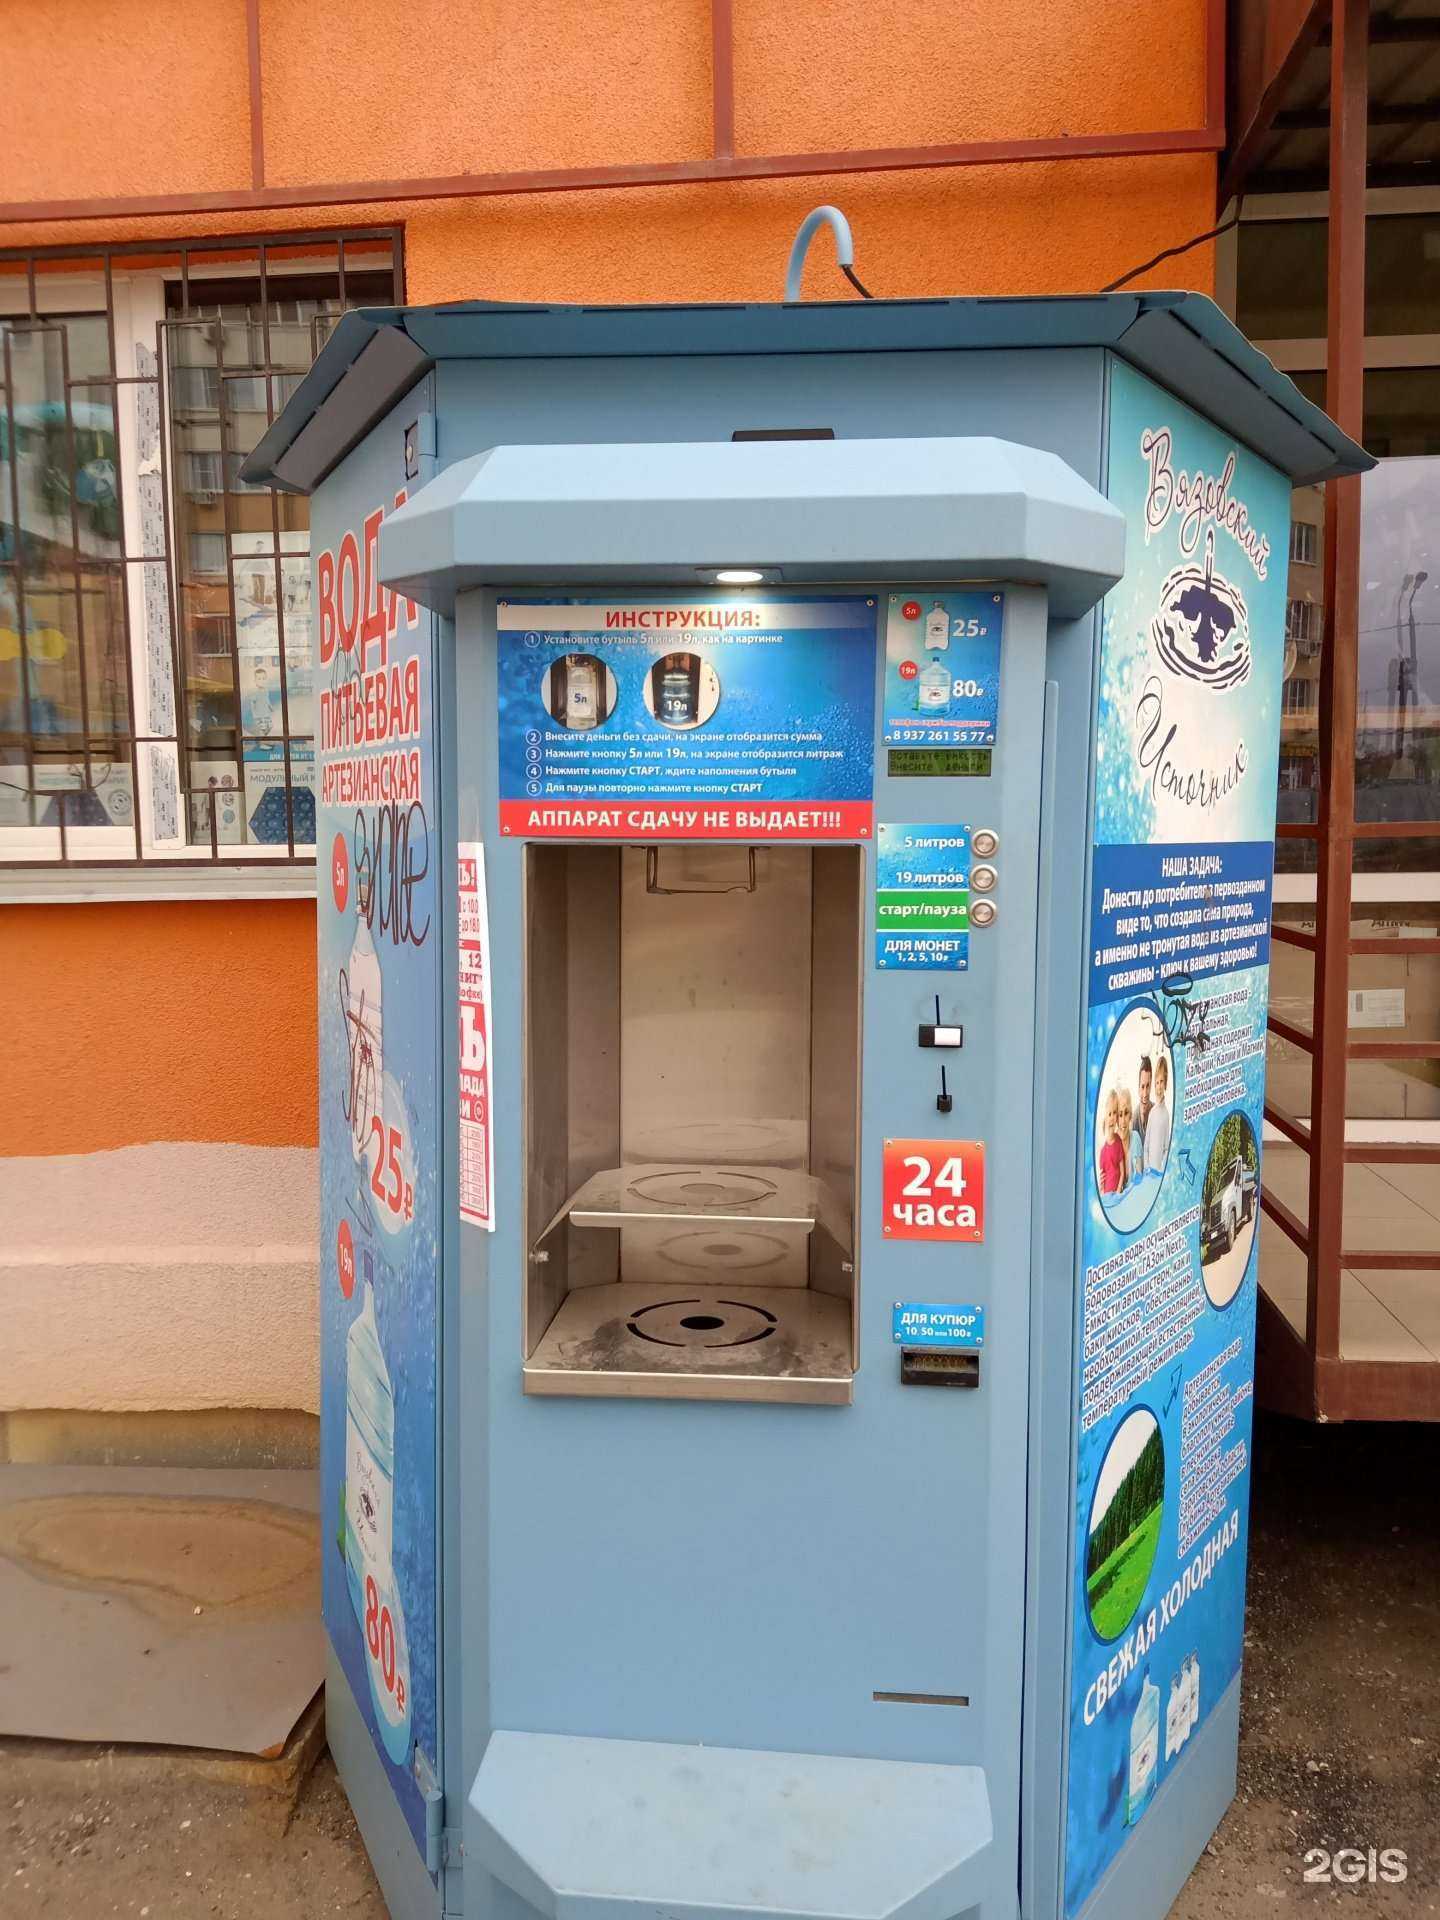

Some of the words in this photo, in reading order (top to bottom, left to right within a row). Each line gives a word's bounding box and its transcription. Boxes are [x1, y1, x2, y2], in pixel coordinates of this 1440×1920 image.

[1143, 432, 1269, 576] Вязовский
[605, 610, 760, 630] ИНСТРУКЦИЯ:
[544, 634, 600, 645] Установите
[601, 634, 638, 646] бутыль
[640, 633, 653, 644] 5л
[655, 635, 673, 644] или
[702, 634, 720, 645] как
[722, 635, 734, 644] на
[736, 634, 784, 646] картинке
[320, 658, 419, 751] ПИТЬЕВАЯ
[574, 692, 588, 703] 5л
[666, 700, 688, 712] 19л
[545, 731, 584, 741] Внесите
[586, 732, 621, 743] деньги
[623, 731, 640, 741] без
[642, 733, 673, 743] сдачи,
[676, 733, 687, 741] на
[690, 732, 724, 743] экране
[726, 730, 788, 743] отобразится
[790, 732, 823, 743] сумма
[893, 731, 900, 740] 8
[903, 731, 925, 741] 937
[928, 731, 949, 741] 261
[953, 732, 967, 741] 55
[970, 732, 985, 742] 77
[1136, 675, 1247, 808] Источник
[545, 748, 590, 759] Нажмите
[592, 750, 627, 761] кнопку
[629, 747, 643, 759] 5л
[644, 751, 663, 759] или
[666, 747, 689, 761] 19л,
[691, 751, 703, 759] на
[705, 750, 739, 760] экране
[741, 748, 804, 760] отобразится
[805, 750, 844, 760] литраж
[321, 752, 419, 802] АРТЕЗИАНСКАЯ
[545, 765, 590, 776] Нажмите
[592, 767, 627, 778] кнопку
[629, 766, 663, 777] СТАРТ,
[665, 767, 697, 778] ждите
[698, 767, 758, 777] наполнения
[760, 766, 797, 778] бутыля
[545, 782, 565, 794] Для
[566, 785, 597, 795] паузы
[599, 785, 646, 795] повторно
[648, 784, 691, 793] нажмите
[693, 784, 729, 795] кнопку
[730, 783, 763, 793] СТАРТ
[528, 810, 622, 827] АППАРАТ
[627, 810, 698, 830] СДАЧУ
[703, 811, 730, 828] НЕ
[736, 811, 841, 831] ВЫДАЕТ!!!
[905, 837, 913, 848] 5
[915, 838, 965, 850] литров
[335, 861, 345, 887] 5л
[896, 872, 912, 884] 19
[914, 873, 964, 885] литров
[1161, 856, 1189, 878] НАША
[1189, 854, 1223, 879] ЗАДАЧА:
[1102, 888, 1142, 914] Донести
[1142, 888, 1155, 909] до
[1155, 881, 1208, 907] потребителя
[1214, 878, 1266, 898] первозданном
[879, 903, 967, 917] старт/пауза
[1116, 917, 1139, 938] виде
[1140, 914, 1153, 933] то,
[1153, 912, 1169, 929] что
[1169, 908, 1202, 930] создала
[1203, 905, 1222, 923] сама
[1222, 901, 1254, 923] природа,
[884, 939, 912, 954] ДЛЯ
[914, 939, 961, 951] МОНЕТ
[1095, 951, 1102, 967] а
[1102, 943, 1139, 965] именно
[1139, 940, 1151, 957] не
[1151, 933, 1190, 959] тронутая
[1190, 930, 1210, 951] вода
[1210, 928, 1219, 942] из
[1220, 918, 1268, 945] артезианской
[897, 952, 906, 963] 1,
[919, 952, 928, 963] 5,
[1108, 965, 1155, 990] скважины
[1160, 959, 1184, 979] ключ
[1184, 959, 1189, 973] к
[1190, 953, 1219, 973] вашему
[1219, 942, 1258, 966] здоровью!
[1233, 989, 1248, 1004] вода
[1223, 1025, 1253, 1046] содержит
[1185, 1071, 1230, 1098] необходимые
[1230, 1066, 1242, 1082] для
[1184, 1097, 1216, 1121] здоровья
[902, 1155, 967, 1198] 24
[892, 1203, 977, 1228] часа
[1087, 1254, 1124, 1289] Доставка
[1125, 1243, 1146, 1263] воды
[1146, 1206, 1200, 1248] осуществляется
[1085, 1301, 1121, 1335] Емкости
[1173, 1257, 1186, 1274] как
[1086, 1266, 1137, 1310] водовозами
[901, 1312, 928, 1326] ДЛЯ
[930, 1313, 976, 1327] КУПЮР
[1085, 1333, 1107, 1359] баки
[1146, 1271, 1193, 1315] обеспеченны
[921, 1327, 934, 1336] 50
[1085, 1327, 1141, 1381] необходимой
[1084, 1336, 1158, 1407] поддерживающей
[1184, 1354, 1228, 1400] Артезианская
[1083, 1363, 1149, 1429] температурный
[1148, 1351, 1174, 1380] режим
[1083, 1607, 1157, 1727] СВЕЖАЯ
[1159, 1509, 1239, 1633] ХОЛОДНАЯ
